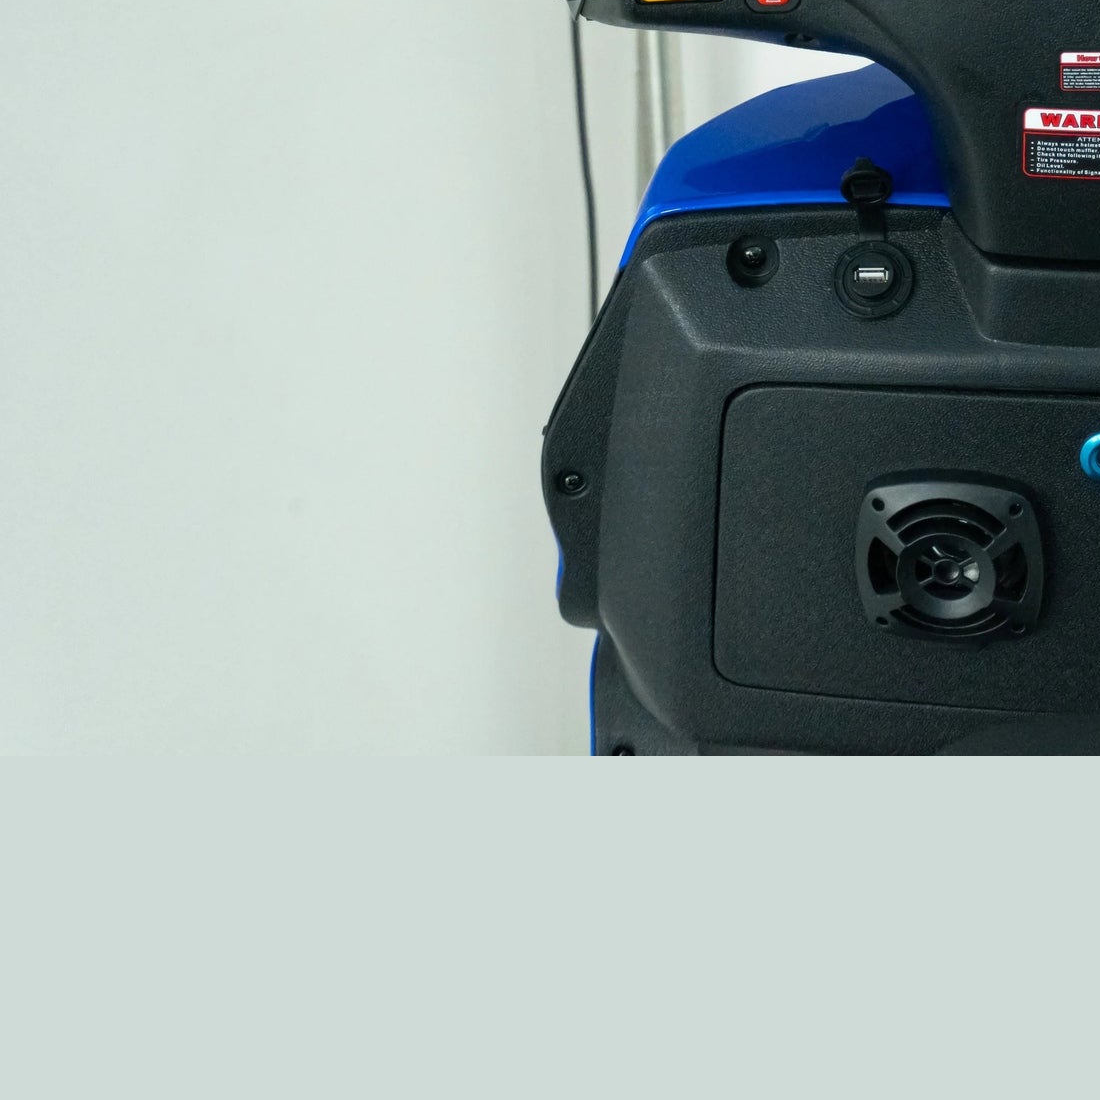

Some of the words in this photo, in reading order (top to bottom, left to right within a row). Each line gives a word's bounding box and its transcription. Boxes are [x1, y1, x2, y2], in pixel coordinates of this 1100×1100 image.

[1076, 54, 1098, 62] How
[1036, 140, 1059, 148] Always
[1067, 152, 1096, 160] following
[1036, 168, 1076, 176] Functionality
